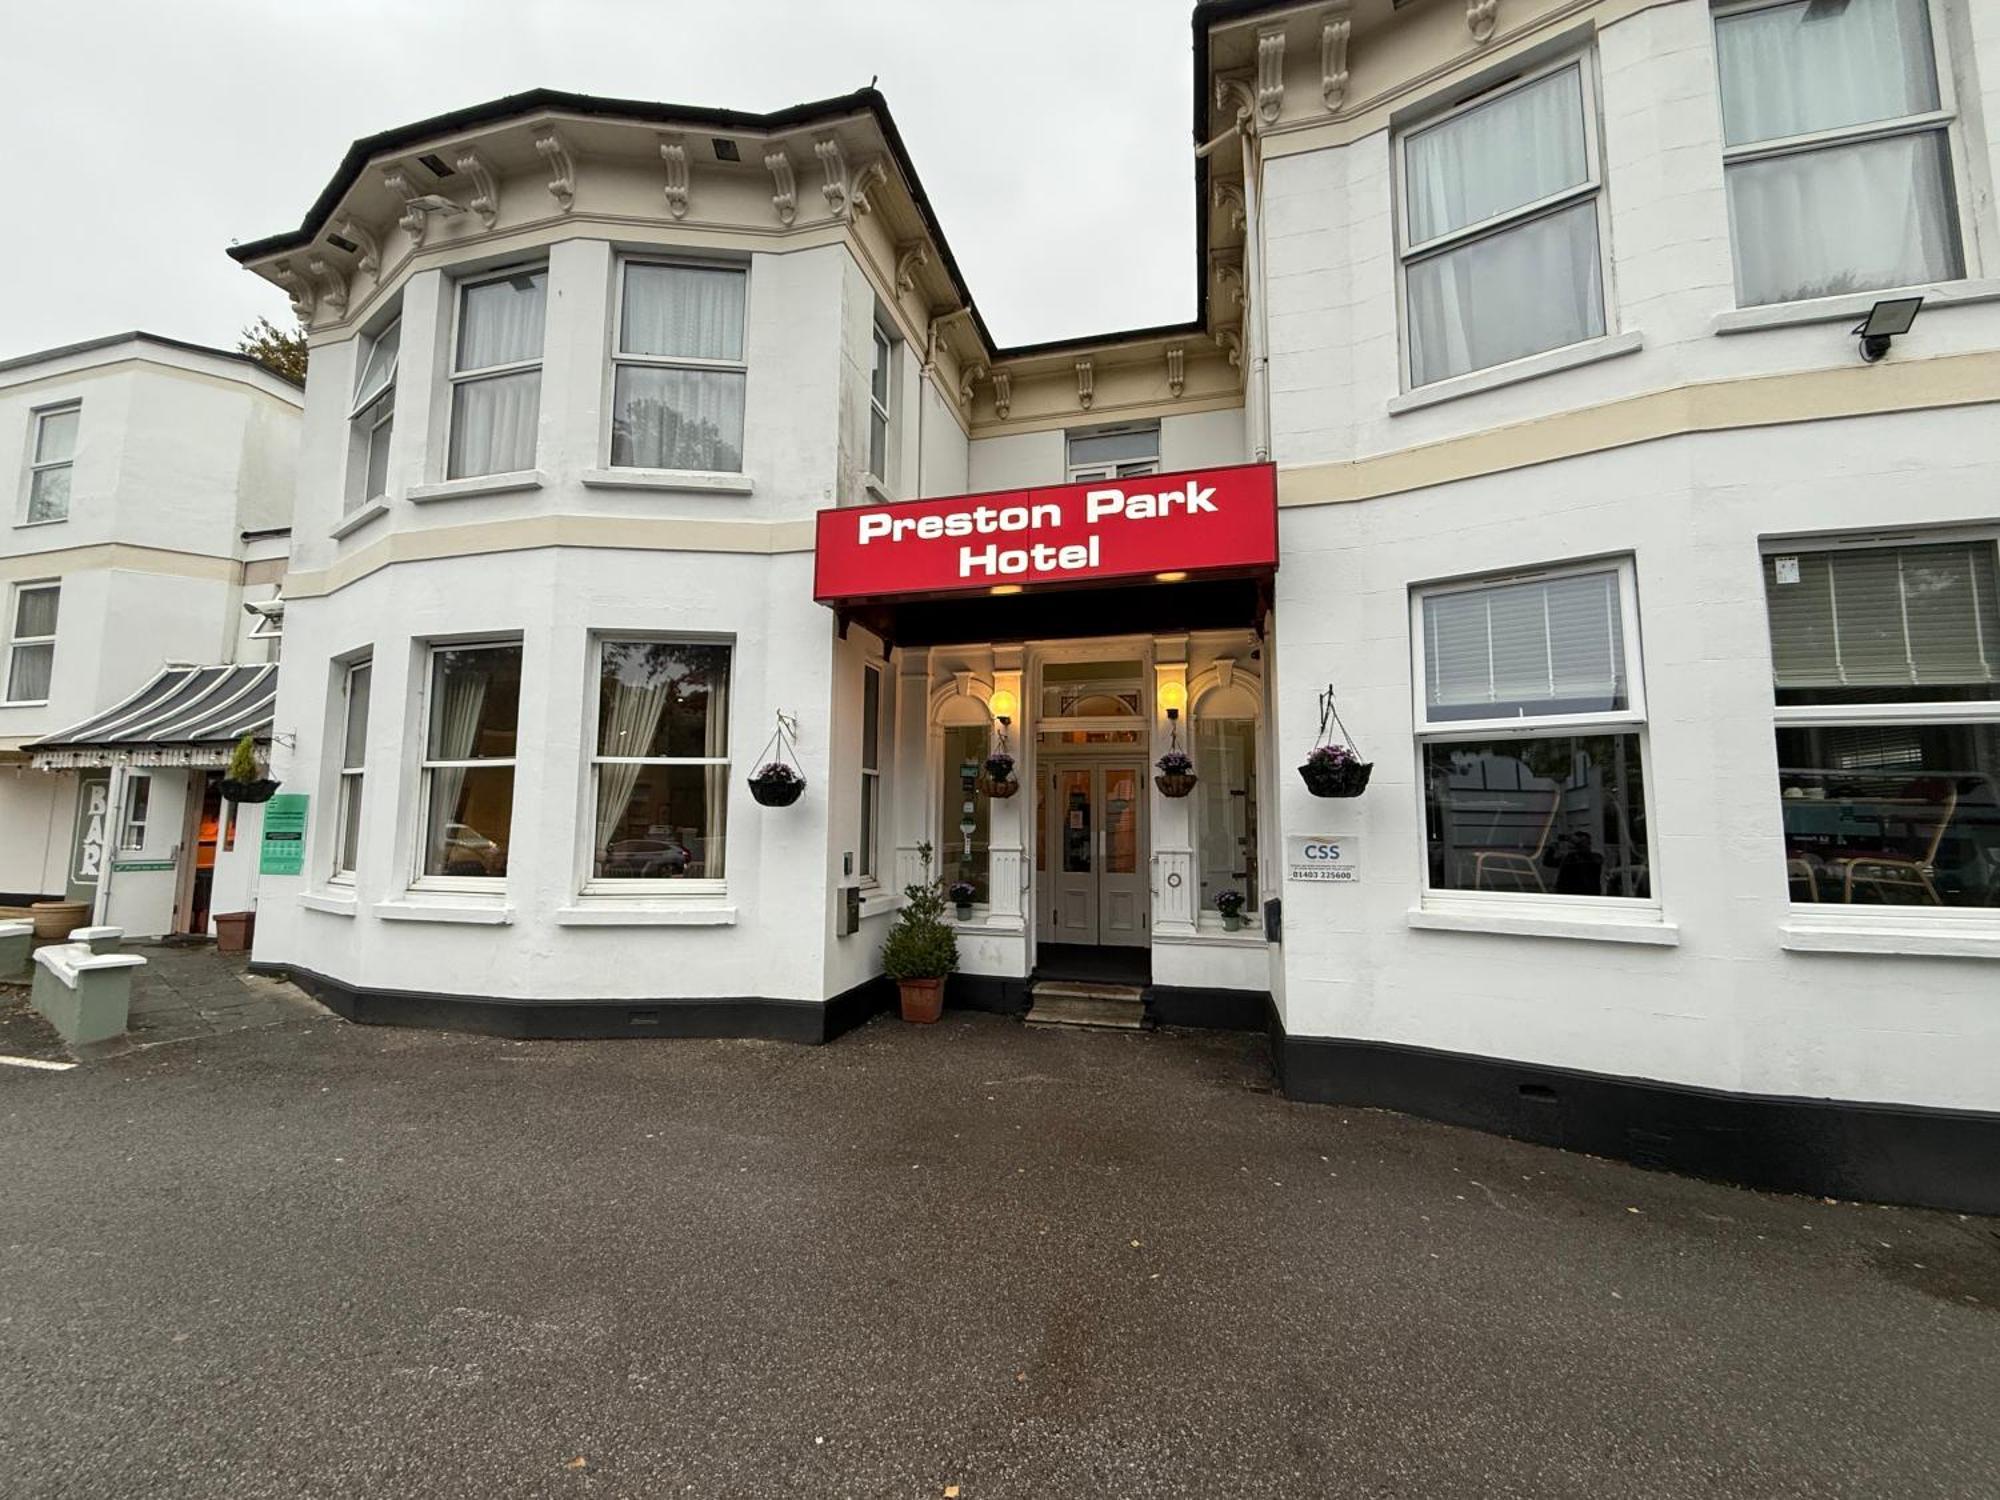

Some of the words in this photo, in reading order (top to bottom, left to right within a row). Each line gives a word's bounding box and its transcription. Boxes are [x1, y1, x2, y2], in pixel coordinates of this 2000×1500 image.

[858, 503, 1061, 545] Preston
[1086, 481, 1218, 524] Park
[959, 535, 1100, 577] Hotel
[79, 785, 106, 875] BAR
[1304, 845, 1340, 859] CSS
